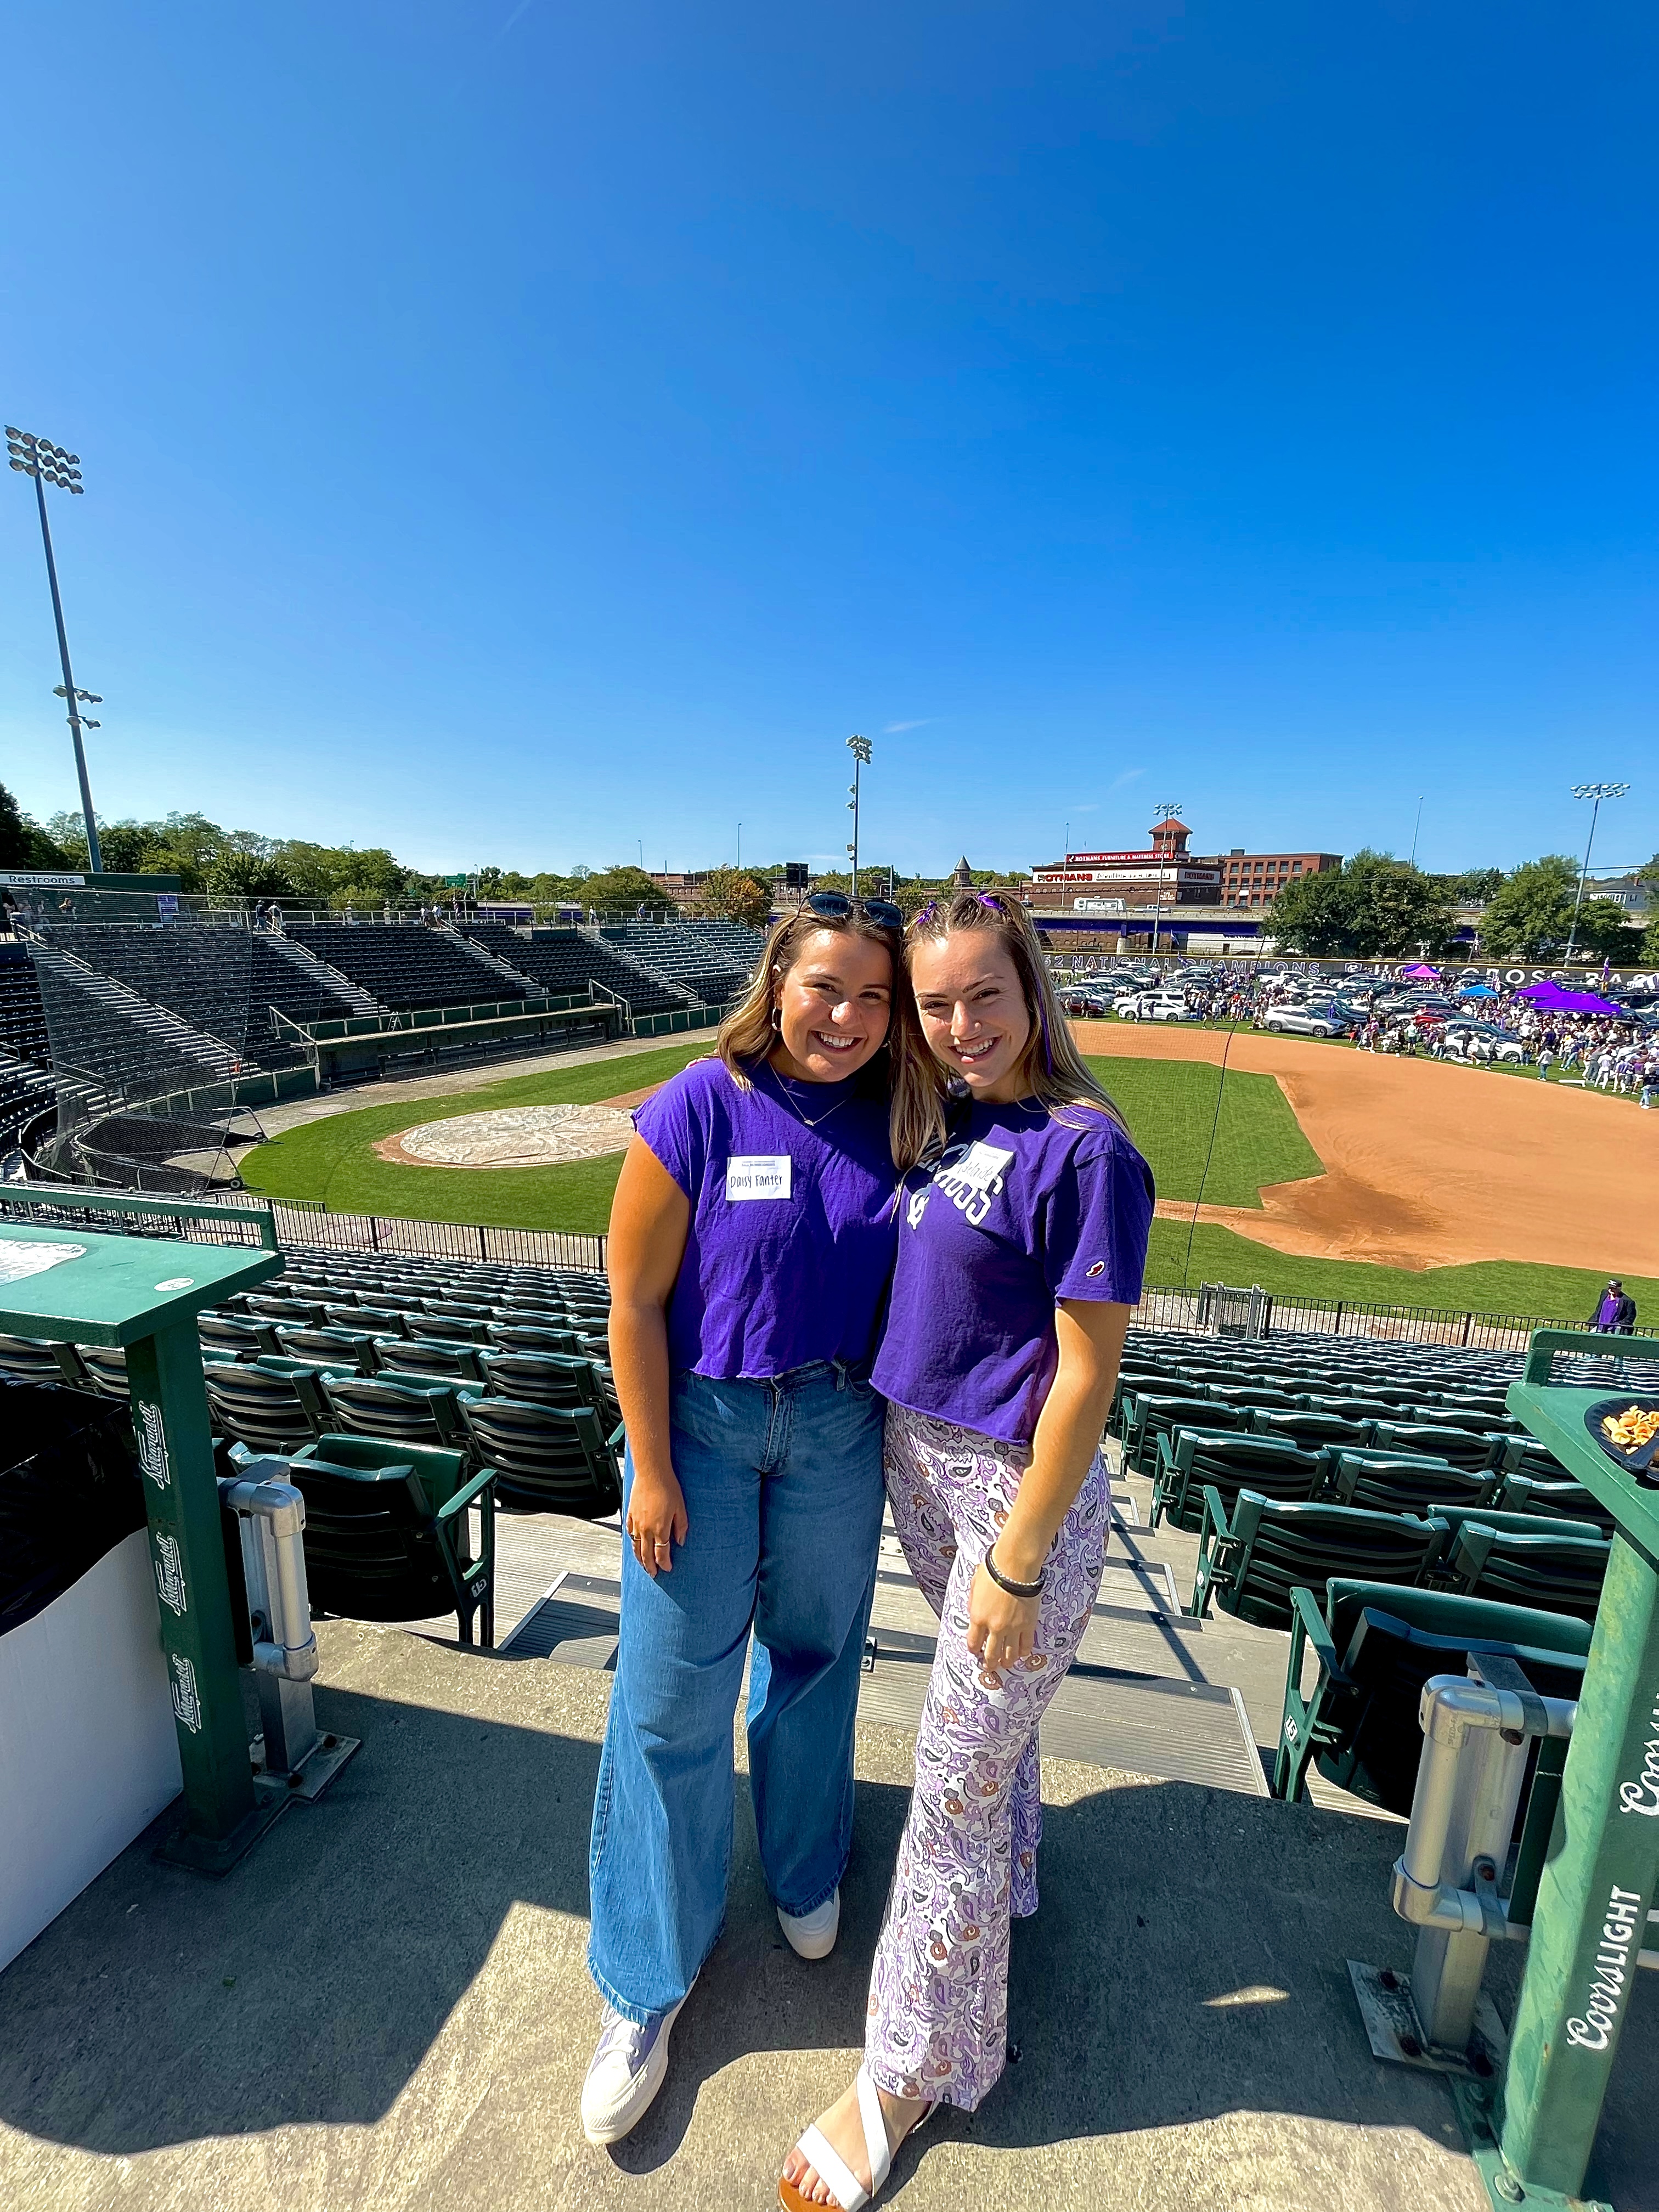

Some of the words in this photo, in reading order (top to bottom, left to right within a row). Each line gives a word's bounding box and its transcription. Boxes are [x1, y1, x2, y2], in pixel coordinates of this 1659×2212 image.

[9, 875, 75, 884] Restrooms
[1038, 873, 1093, 882] ROTMANS
[730, 1176, 752, 1188] Daisy
[1288, 1718, 1296, 1736] 15
